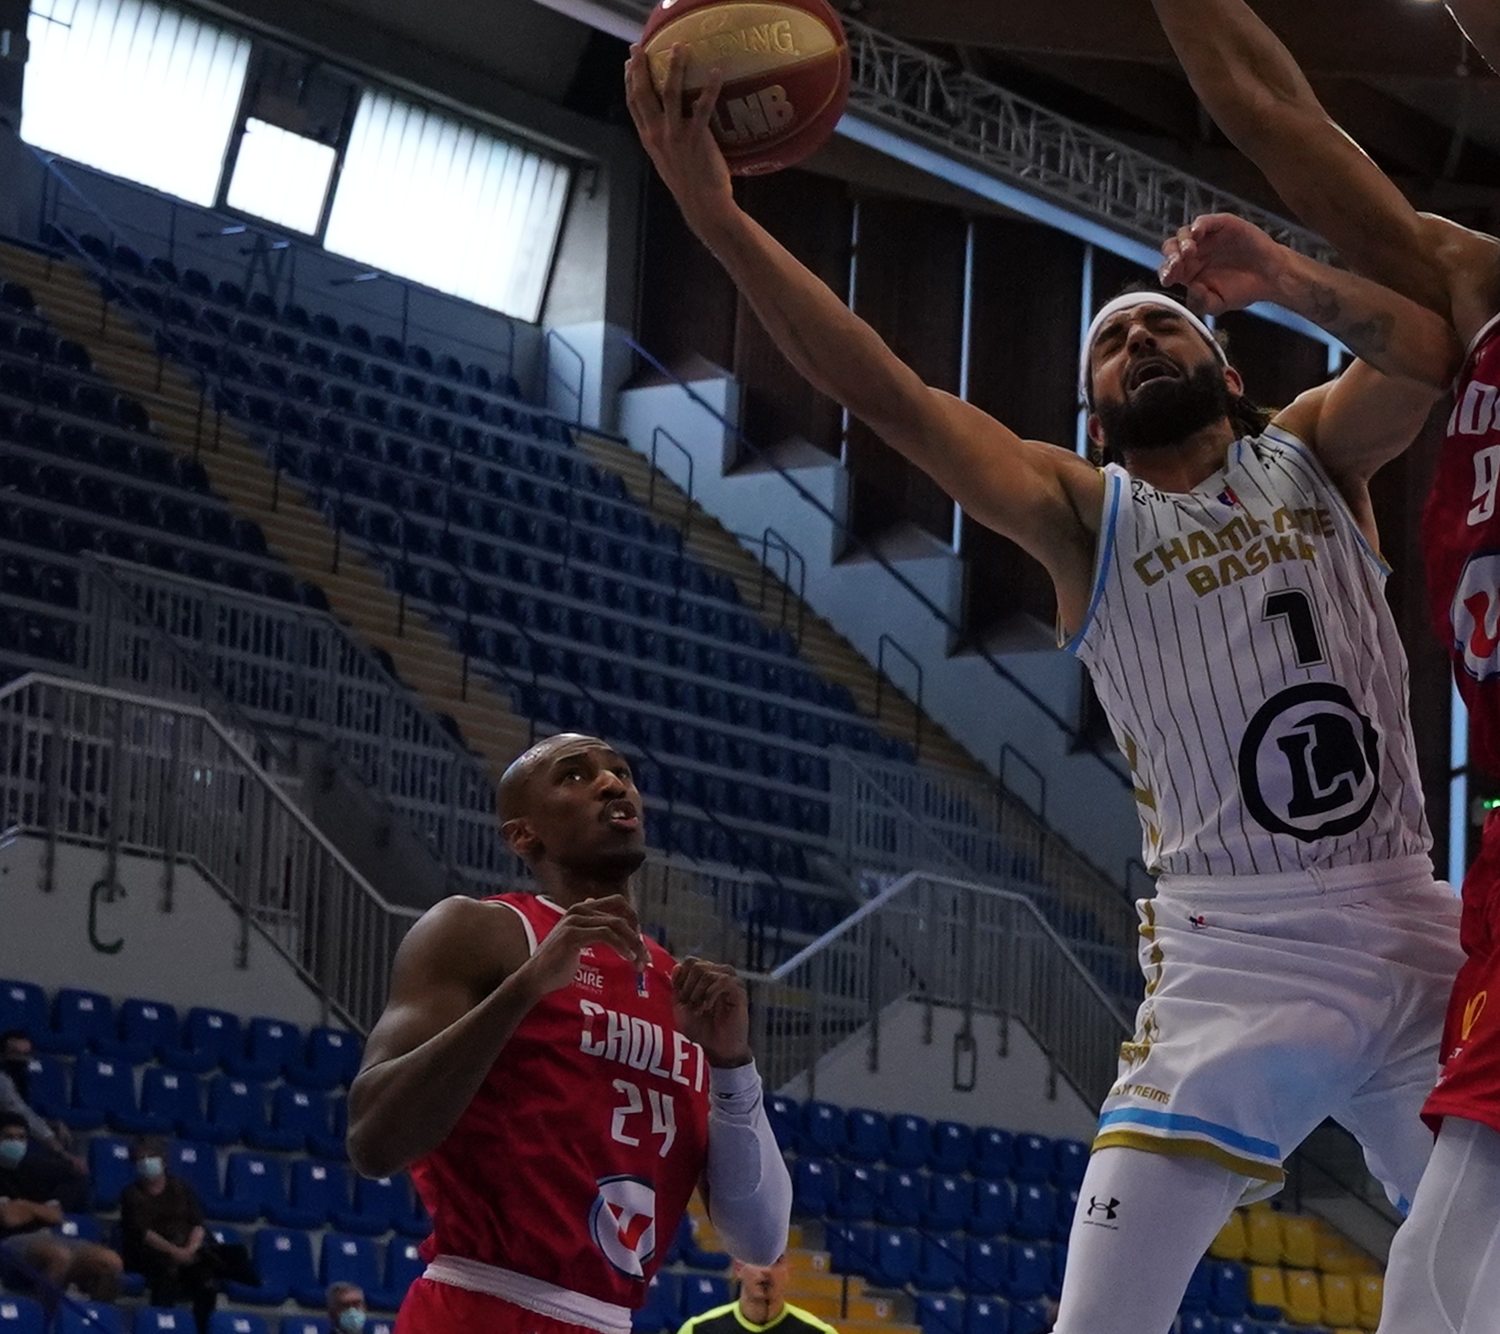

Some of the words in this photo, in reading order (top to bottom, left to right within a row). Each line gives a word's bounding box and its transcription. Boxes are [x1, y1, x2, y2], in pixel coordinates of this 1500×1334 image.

[1262, 588, 1326, 669] 1
[88, 880, 127, 954] C
[579, 999, 704, 1093] CHOLET
[610, 1078, 677, 1157] 24
